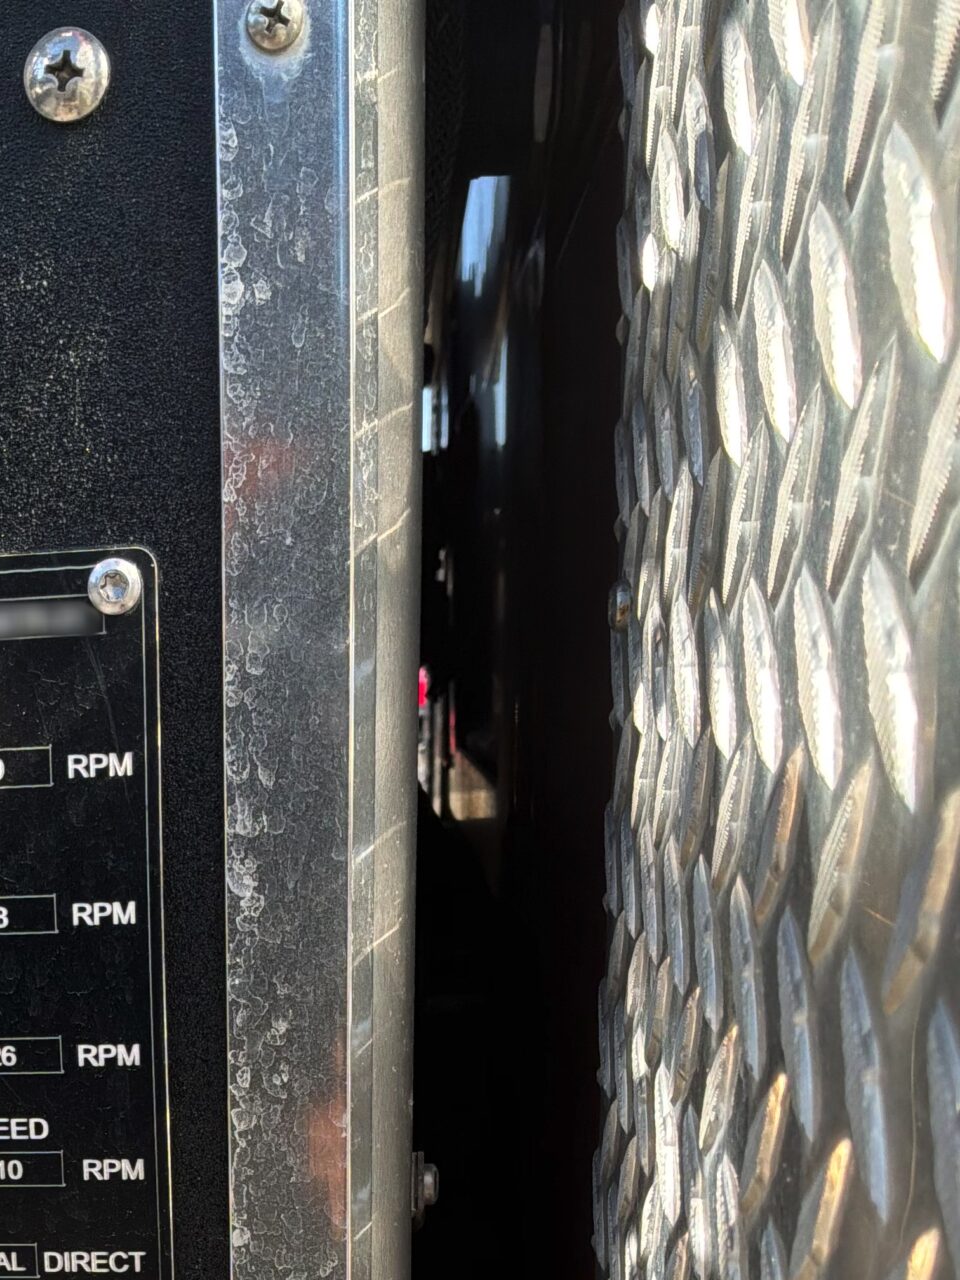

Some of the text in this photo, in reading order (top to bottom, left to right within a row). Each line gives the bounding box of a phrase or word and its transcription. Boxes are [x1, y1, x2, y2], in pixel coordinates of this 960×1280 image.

[68, 752, 132, 778] RPM
[73, 901, 135, 925] RPM
[78, 1044, 140, 1066] RPM
[83, 1159, 144, 1180] RPM
[44, 1251, 146, 1272] DIRECT
